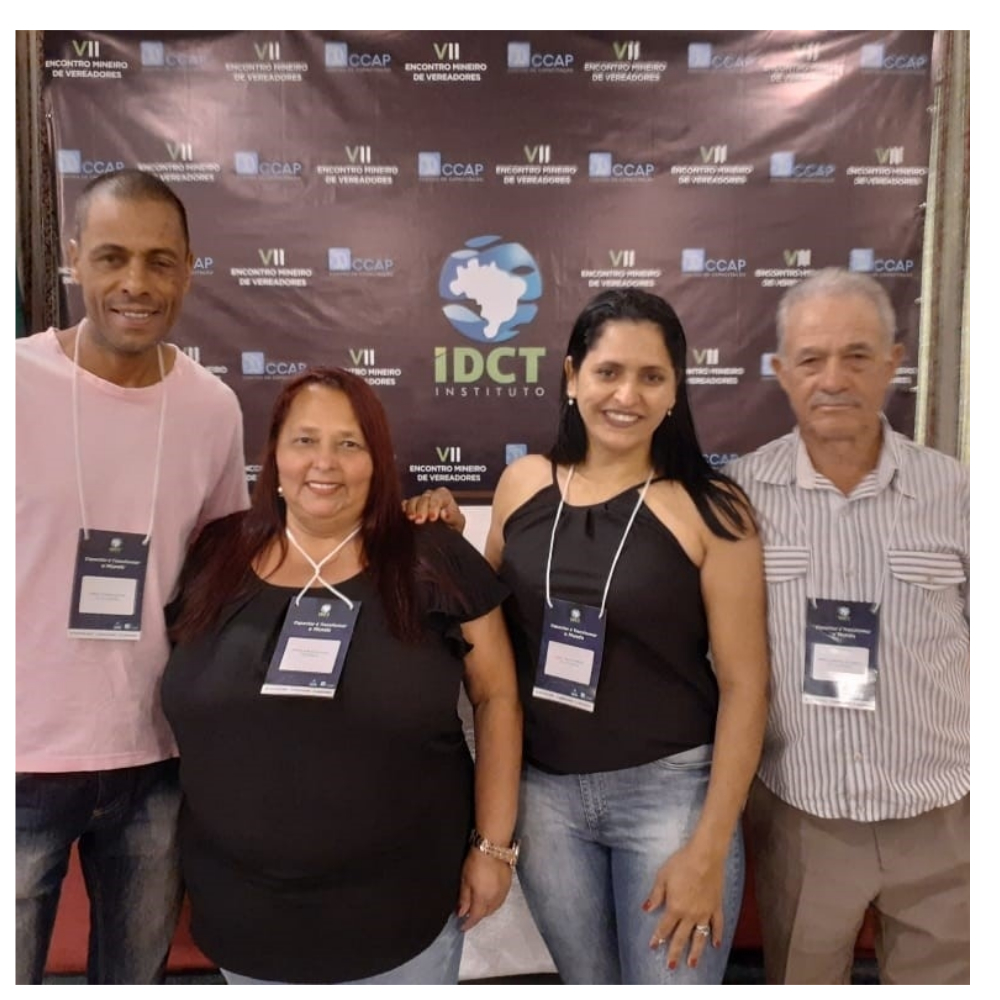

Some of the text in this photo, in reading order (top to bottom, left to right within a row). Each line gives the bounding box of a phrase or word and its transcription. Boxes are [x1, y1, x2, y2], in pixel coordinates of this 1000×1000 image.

[73, 41, 100, 57] VII
[253, 42, 280, 58] VII
[433, 44, 459, 60] VII
[613, 42, 640, 58] VII
[46, 60, 128, 69] ENCONTRO MINEIRO
[349, 53, 391, 67] CCAP
[531, 53, 574, 67] CCAP
[584, 62, 666, 70] ENCONTRO MINEIRO
[884, 56, 927, 70] CCAP
[66, 71, 121, 79] VEREADORES
[226, 64, 308, 72] ENCONTRO MINEIRO
[405, 64, 486, 72] ENCONTRO MINEIRO
[234, 74, 301, 82] DE VEREADORES
[413, 74, 480, 82] DE VEREADORES
[592, 72, 659, 82] DE VEREADORES
[165, 144, 192, 160] VII
[345, 146, 371, 162] VII
[523, 145, 550, 163] VII
[700, 145, 727, 162] VII
[82, 160, 124, 174] CCAP
[259, 160, 301, 174] CCAP
[317, 166, 398, 174] ENCONTRO MINEIRO
[441, 163, 483, 177] CCAP
[496, 166, 578, 174] ENCONTRO MINEIRO
[612, 163, 654, 177] CCAP
[793, 164, 835, 178] CCAP
[325, 176, 392, 184] DE VEREADORES
[504, 176, 571, 184] DE VEREADORES
[258, 248, 285, 266] VII
[608, 250, 635, 266] VII
[352, 258, 394, 271] CCAP
[705, 259, 746, 273] CCAP
[874, 259, 914, 273] CCAP
[231, 268, 312, 276] ENCONTRO MINEIRO
[581, 270, 626, 278] ENCONTRO
[239, 278, 306, 286] DE VEREADORES
[589, 280, 599, 288] DE
[349, 349, 375, 365] VII
[693, 348, 719, 365] VII
[265, 362, 306, 376] CCAP
[434, 347, 546, 383] IDCT
[368, 369, 401, 377] MINEIRO
[435, 387, 545, 397] INSTITUTO
[437, 447, 461, 462] VII
